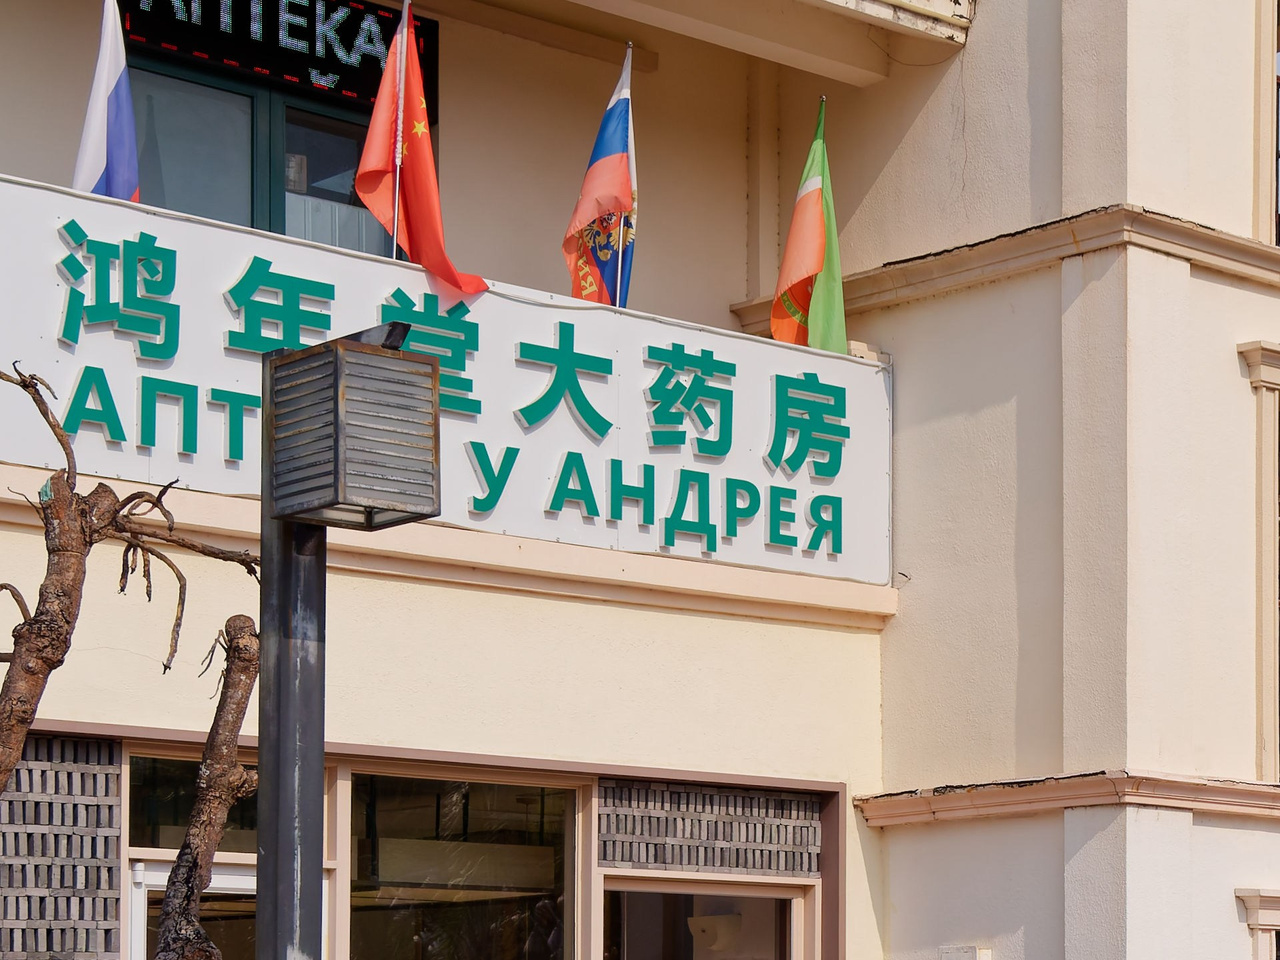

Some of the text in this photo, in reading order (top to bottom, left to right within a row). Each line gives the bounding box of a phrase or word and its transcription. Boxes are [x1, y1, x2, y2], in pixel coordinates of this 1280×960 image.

[57, 219, 850, 479] 鸿年堂大药房
[61, 365, 842, 555] АПТ У АНДРЕЯ
